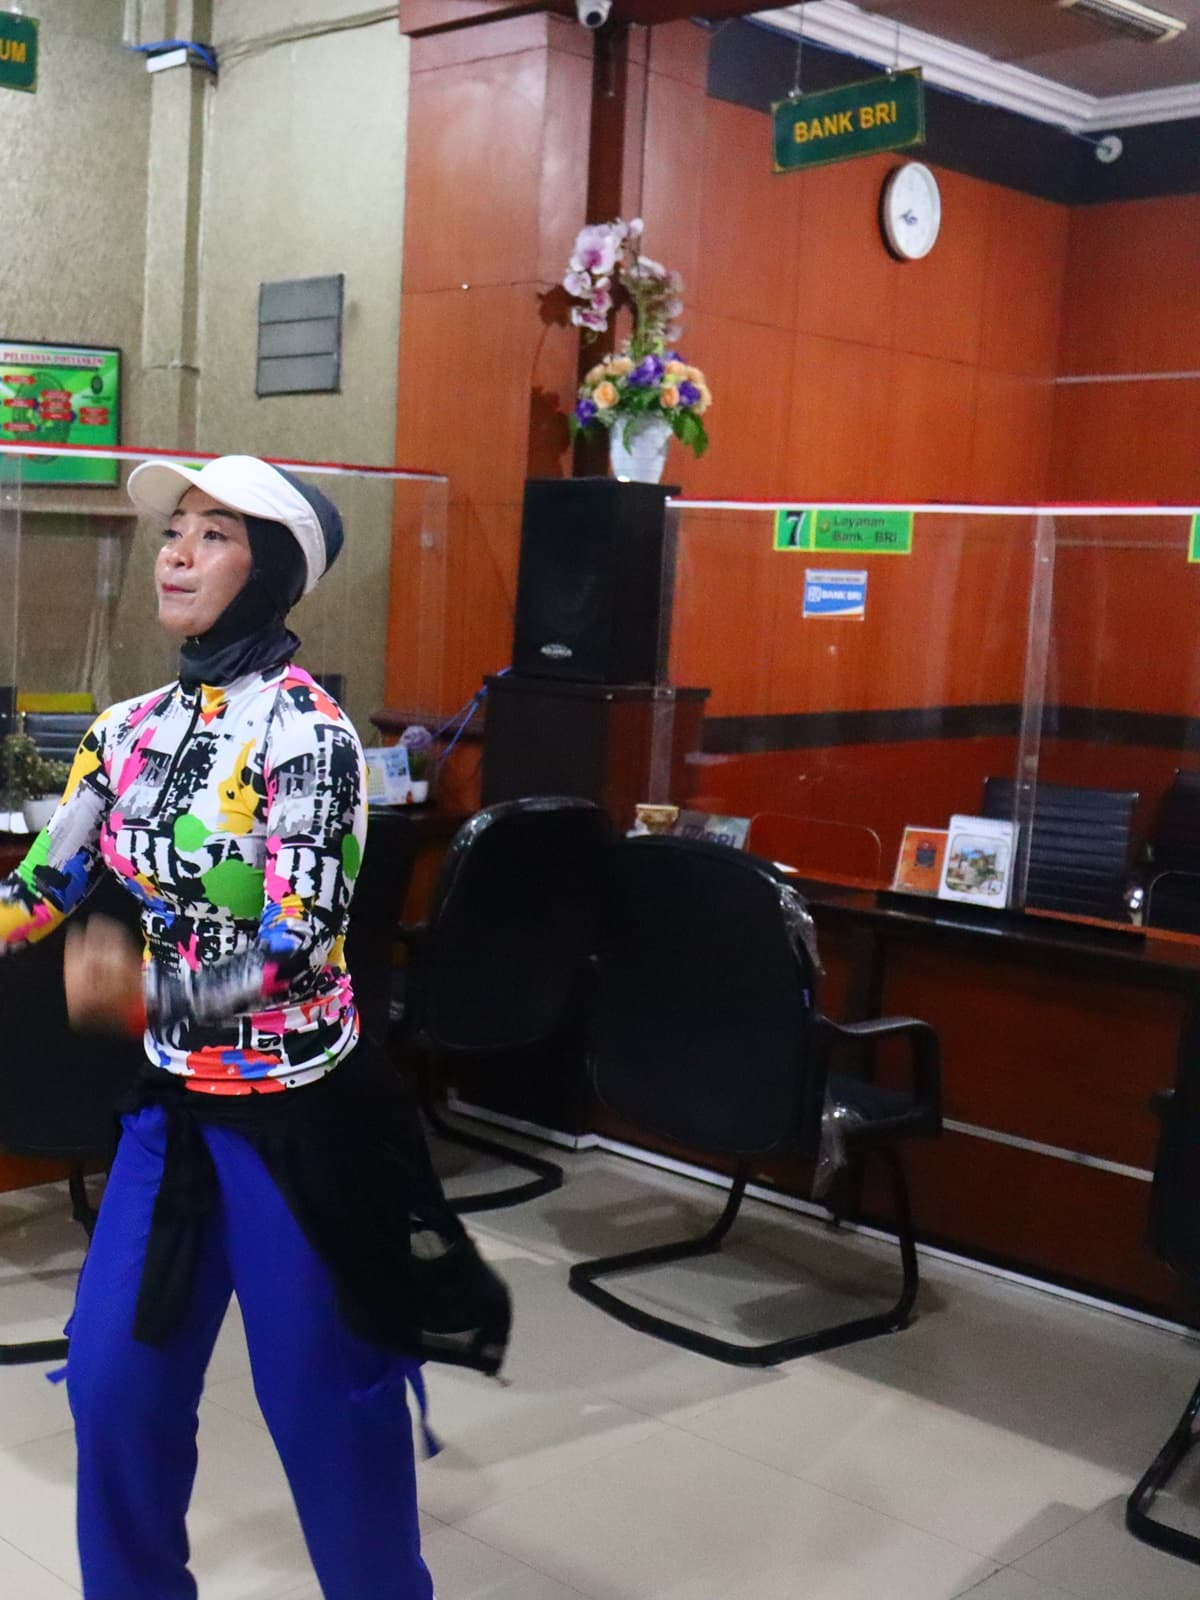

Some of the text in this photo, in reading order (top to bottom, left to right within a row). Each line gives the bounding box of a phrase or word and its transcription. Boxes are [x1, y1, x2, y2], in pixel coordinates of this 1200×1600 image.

[793, 101, 898, 144] BANK BRI
[785, 510, 807, 549] 7
[833, 515, 886, 528] Layanan
